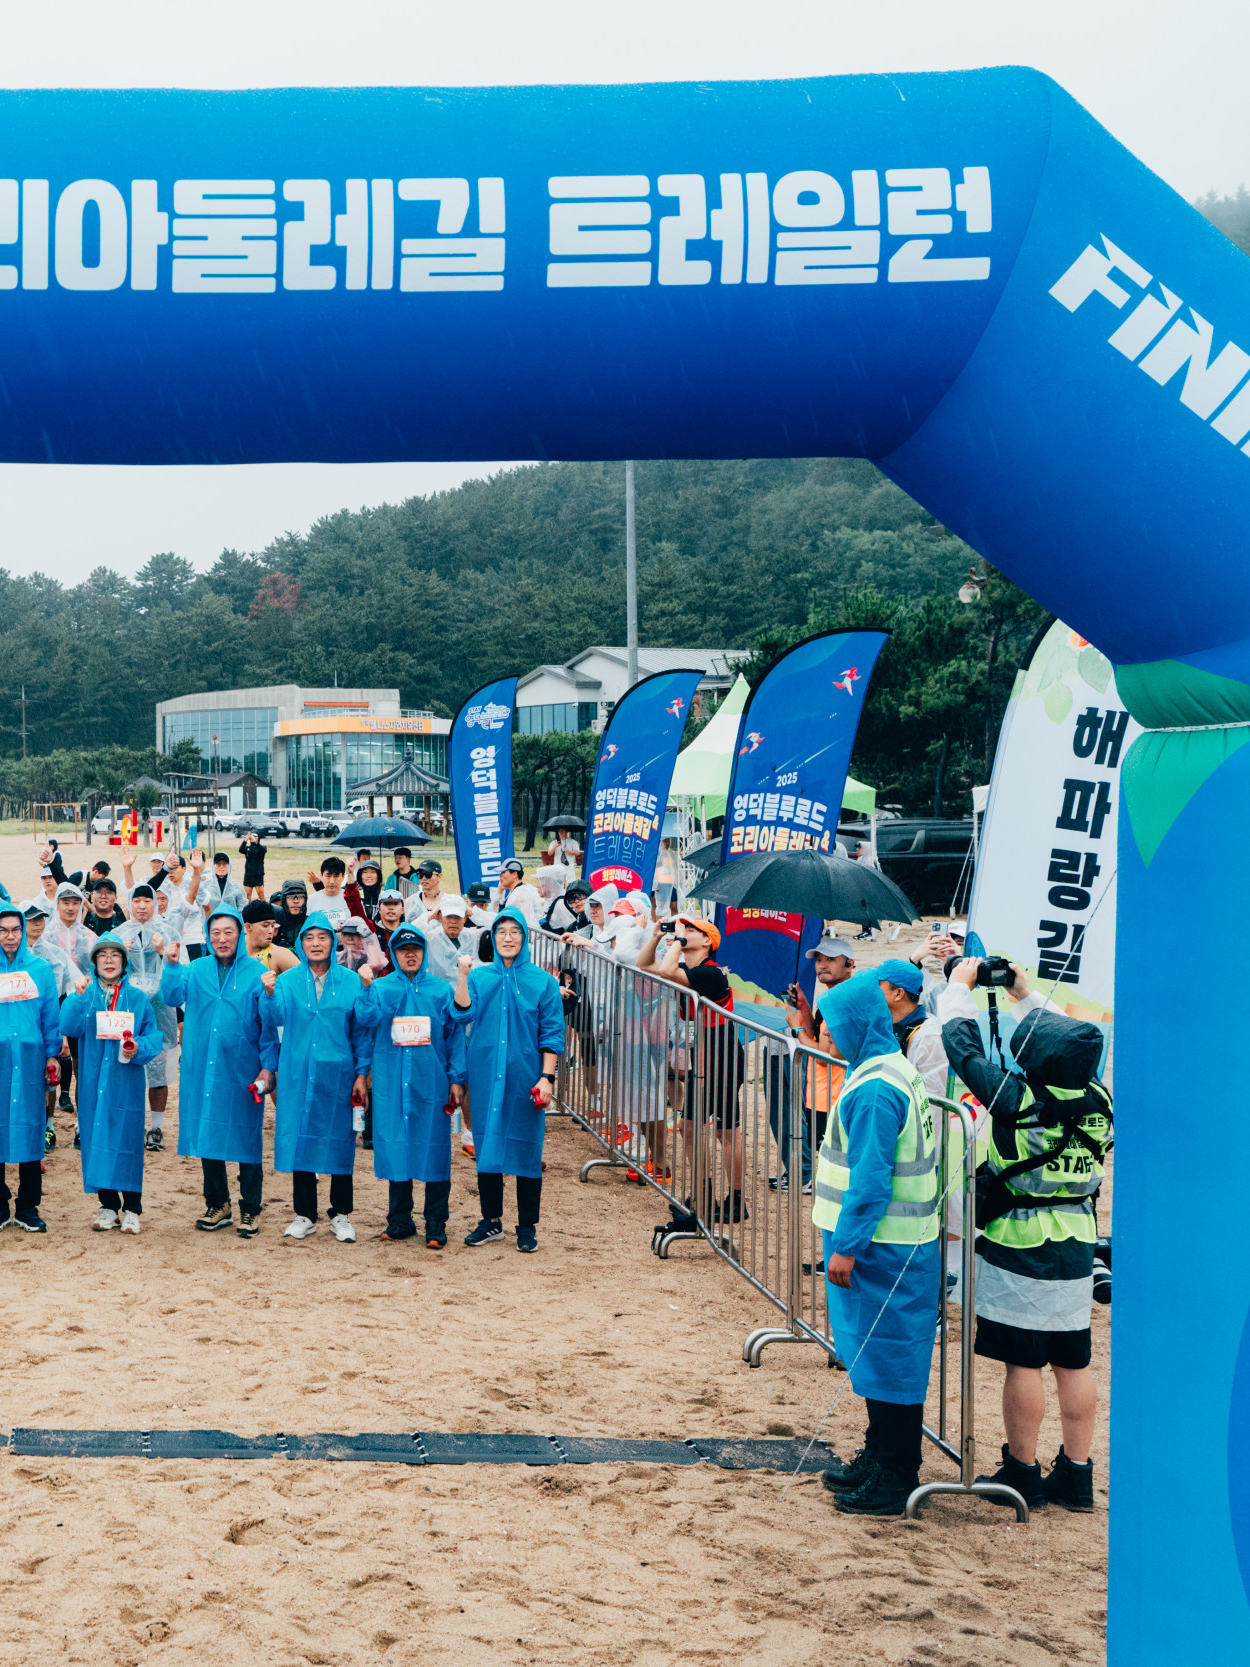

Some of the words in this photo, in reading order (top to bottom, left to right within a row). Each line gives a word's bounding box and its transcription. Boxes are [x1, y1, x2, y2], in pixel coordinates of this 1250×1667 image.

[547, 166, 992, 288] 트레일런
[625, 772, 641, 784] 2025
[776, 771, 798, 787] 2025
[470, 745, 501, 883] 영덕블루로드
[595, 787, 658, 816] 영덕블루로드
[734, 792, 828, 832] 영덕블루로드
[593, 811, 652, 841] 코리아둘레길
[652, 814, 660, 831] &
[593, 835, 647, 869] 트레일런
[821, 830, 831, 852] &
[1037, 706, 1130, 984] 해파랑길
[10, 979, 27, 989] 171
[109, 1018, 126, 1028] 172
[401, 1024, 420, 1034] 170
